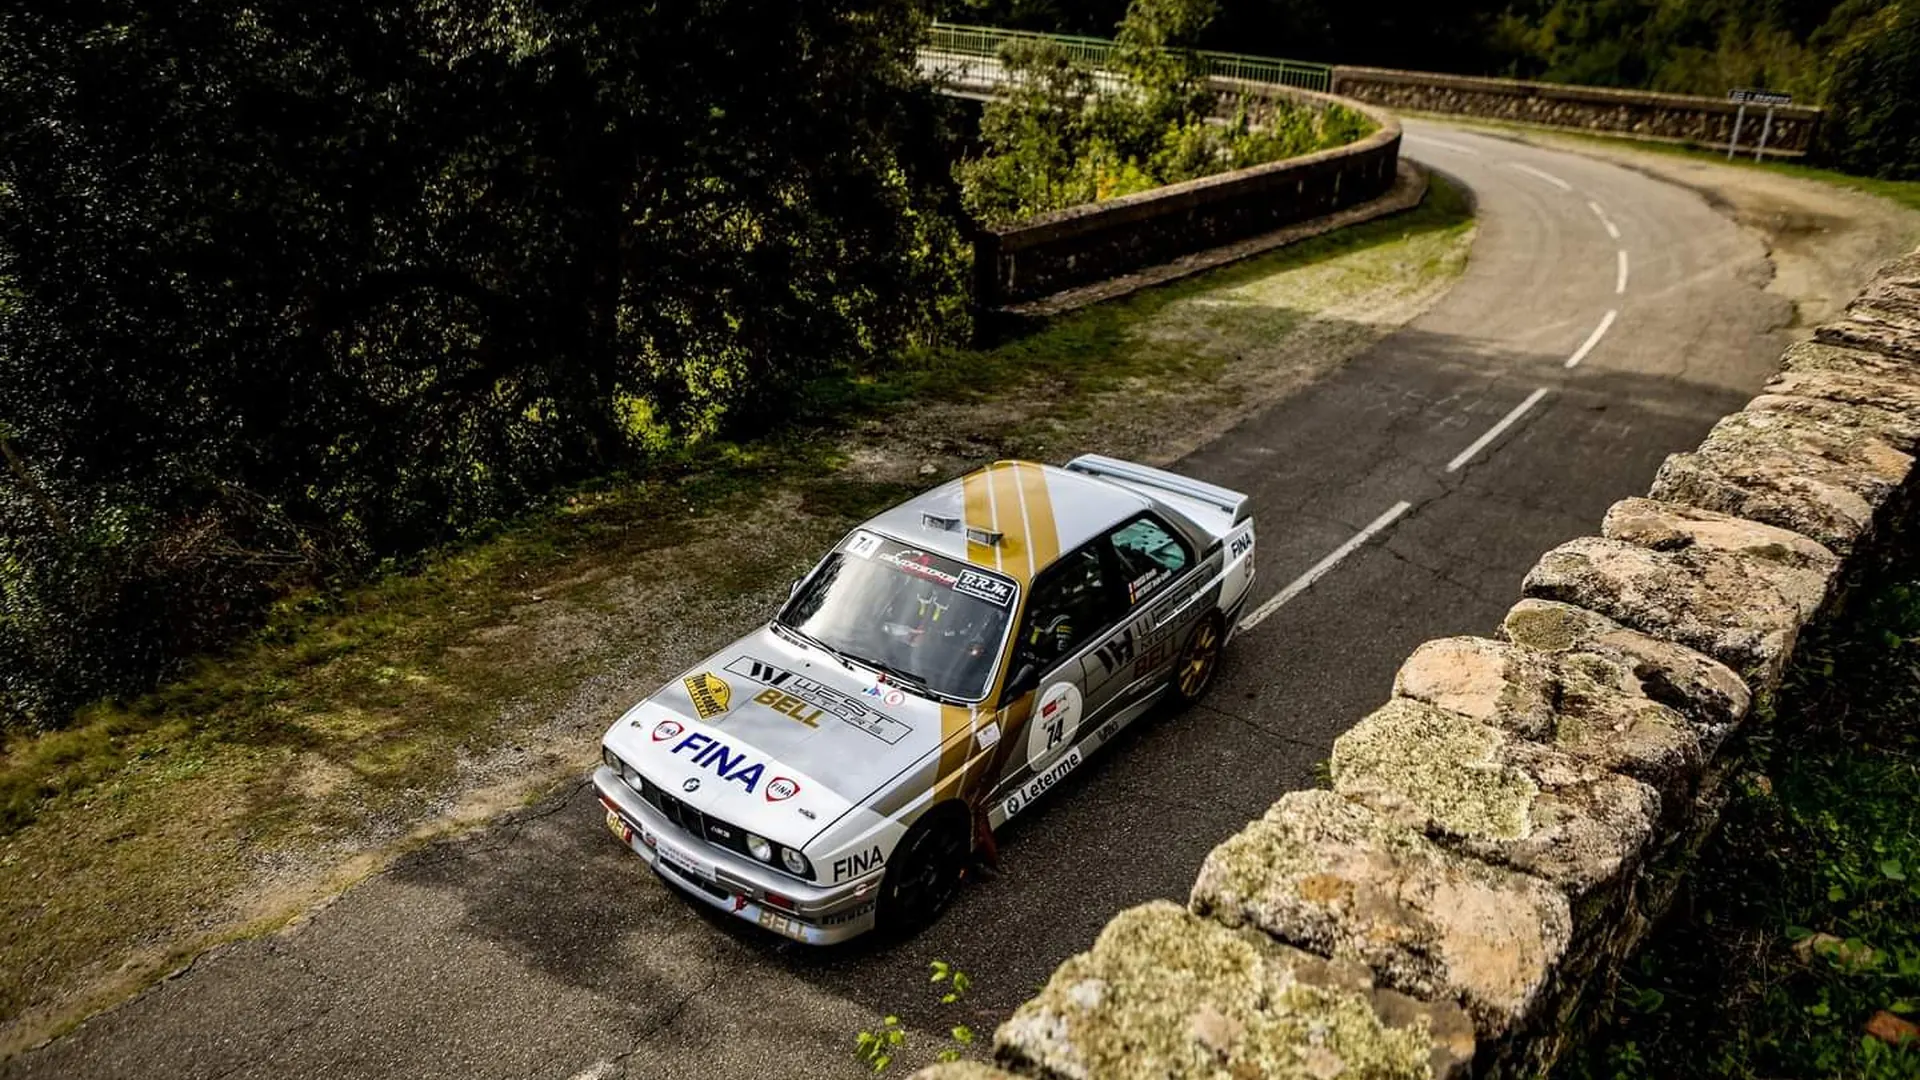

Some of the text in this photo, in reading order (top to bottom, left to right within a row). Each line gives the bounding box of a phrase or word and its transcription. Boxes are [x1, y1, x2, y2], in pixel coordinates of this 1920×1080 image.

[1231, 532, 1252, 559] FINA
[753, 688, 824, 729] BELL
[793, 678, 895, 724] WEST
[658, 725, 677, 737] FINA
[1046, 717, 1065, 750] 74
[671, 732, 767, 794] FINA
[1021, 752, 1079, 804] Leterme
[770, 782, 793, 797] FINA
[833, 845, 884, 883] FINA
